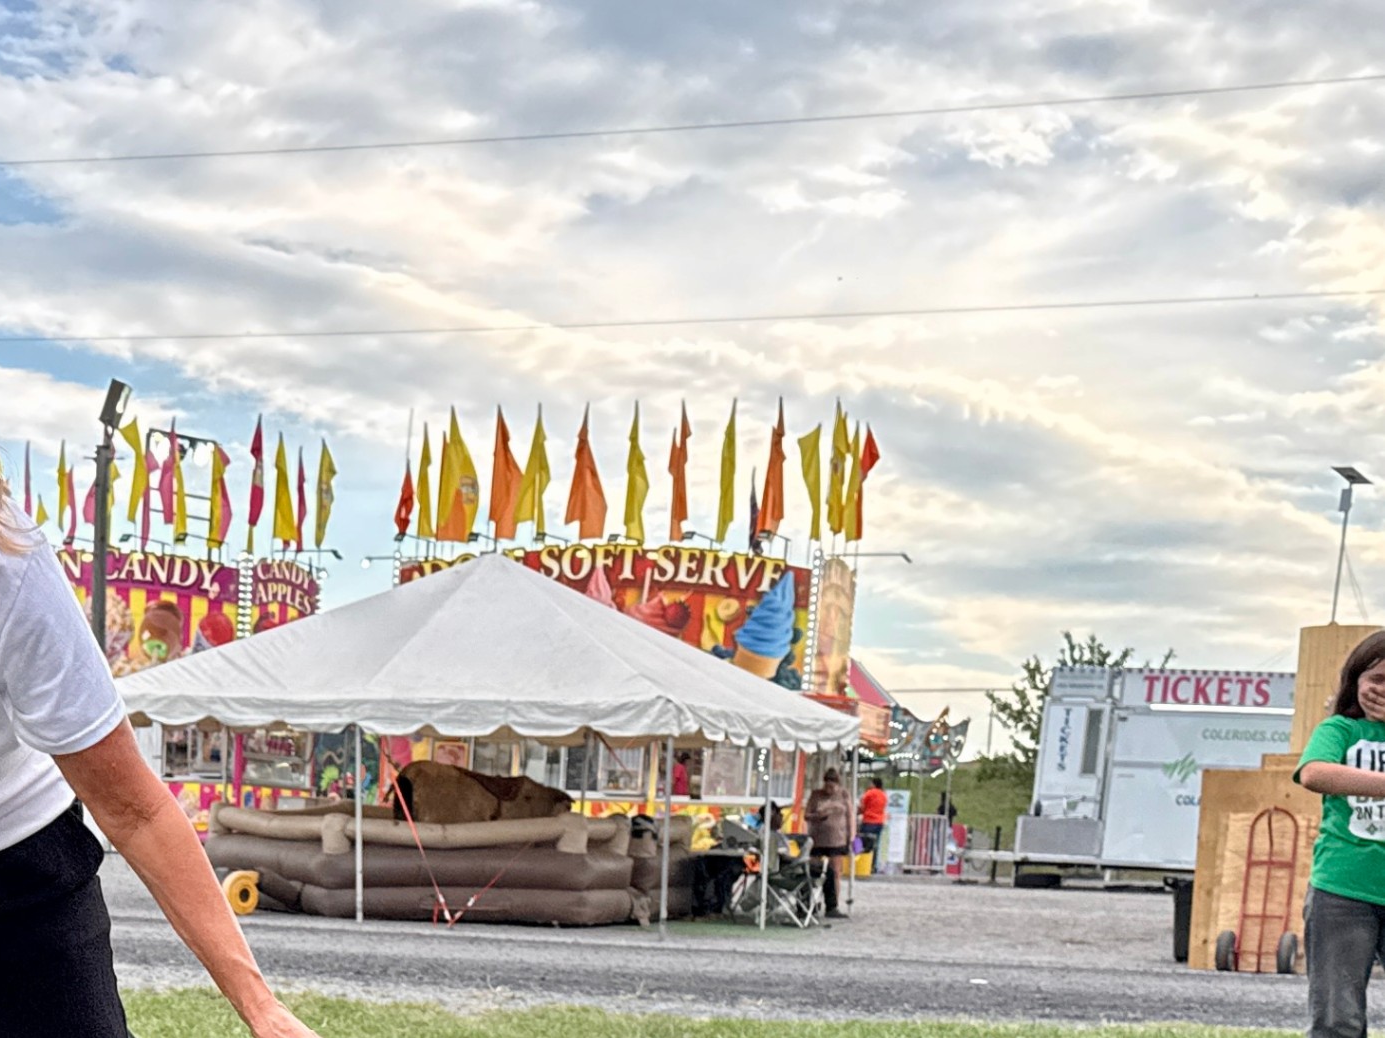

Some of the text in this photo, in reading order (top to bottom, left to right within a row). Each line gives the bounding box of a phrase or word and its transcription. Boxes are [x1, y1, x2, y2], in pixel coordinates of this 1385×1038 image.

[105, 547, 222, 590] CANDY
[256, 557, 313, 589] CANDY
[540, 544, 643, 581] SOFT
[255, 582, 313, 615] APPLES
[1143, 675, 1270, 706] TICKETS
[1201, 728, 1290, 743] COLERIDES.CO
[1175, 794, 1201, 807] COL
